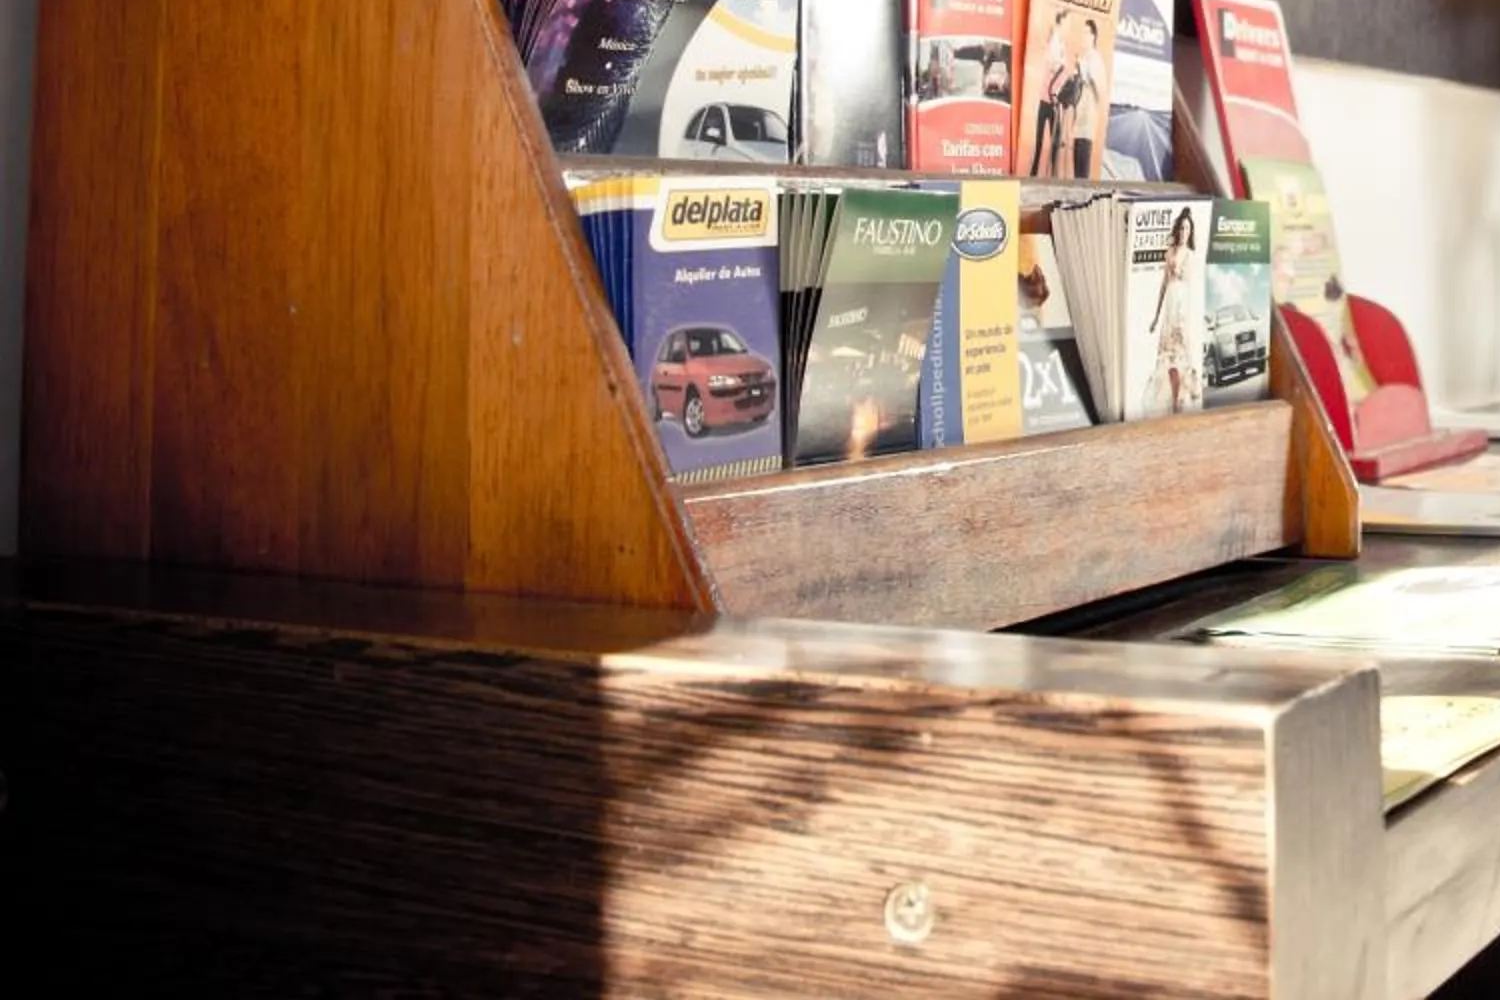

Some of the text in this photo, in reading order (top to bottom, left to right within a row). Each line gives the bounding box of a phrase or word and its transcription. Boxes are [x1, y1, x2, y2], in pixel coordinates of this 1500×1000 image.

[942, 138, 981, 157] Tarifas
[671, 195, 763, 229] delplata
[1136, 208, 1172, 227] OUTLET
[853, 217, 943, 245] FAUSTINO
[674, 265, 761, 284] Alquiler de Autos
